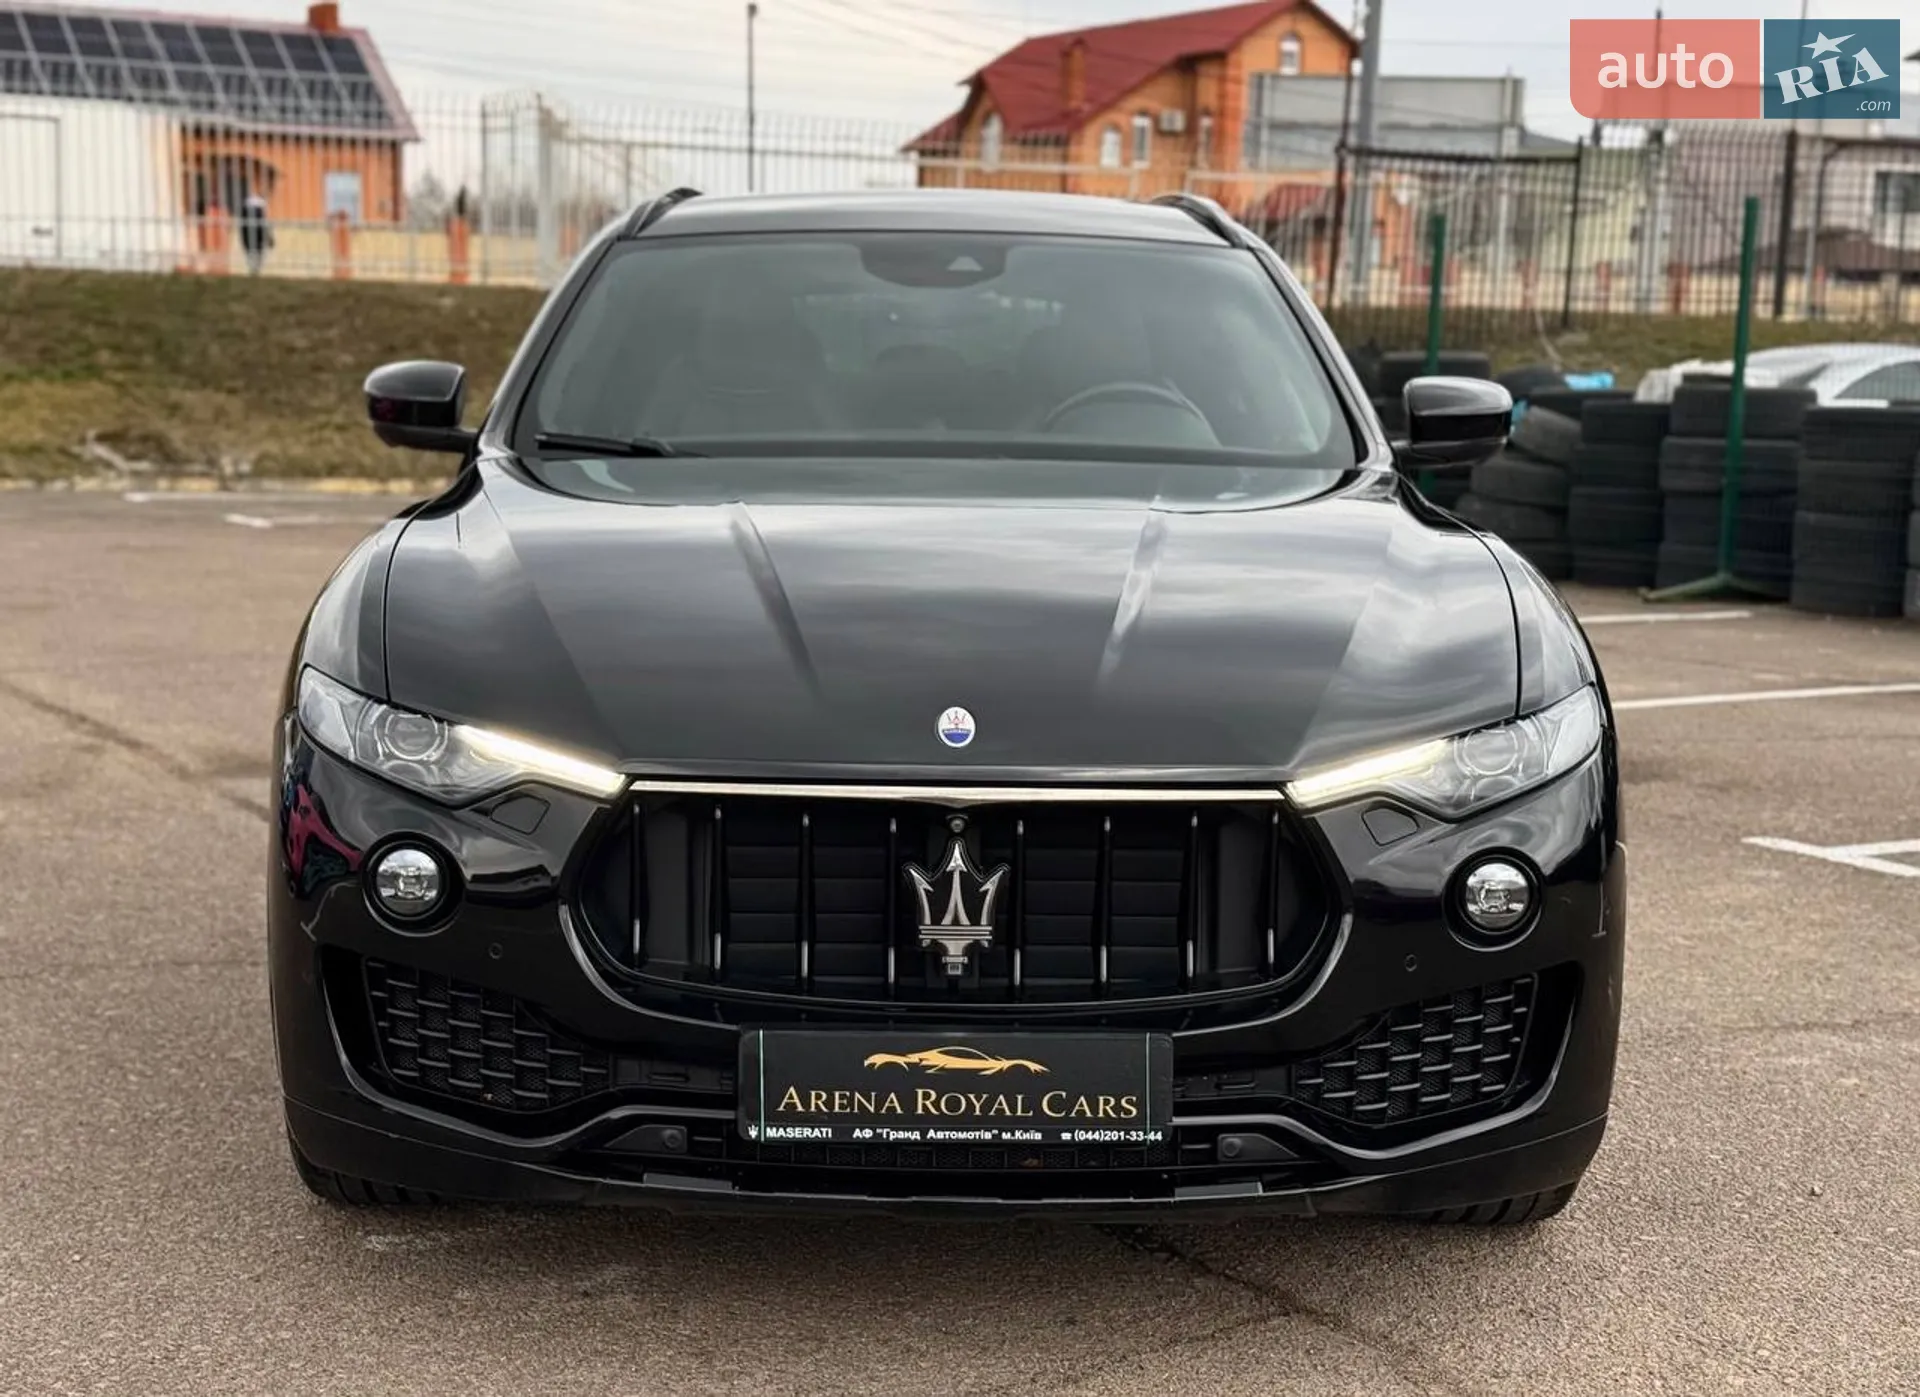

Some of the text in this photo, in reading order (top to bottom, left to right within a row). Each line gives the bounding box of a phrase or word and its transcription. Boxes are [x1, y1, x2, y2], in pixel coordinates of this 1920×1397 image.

[775, 1085, 1138, 1119] ARENA ROYAL CARS
[766, 1127, 832, 1139] MASERATI
[852, 1128, 873, 1139] АФ
[1074, 1130, 1163, 1142] (044)201-33-44
